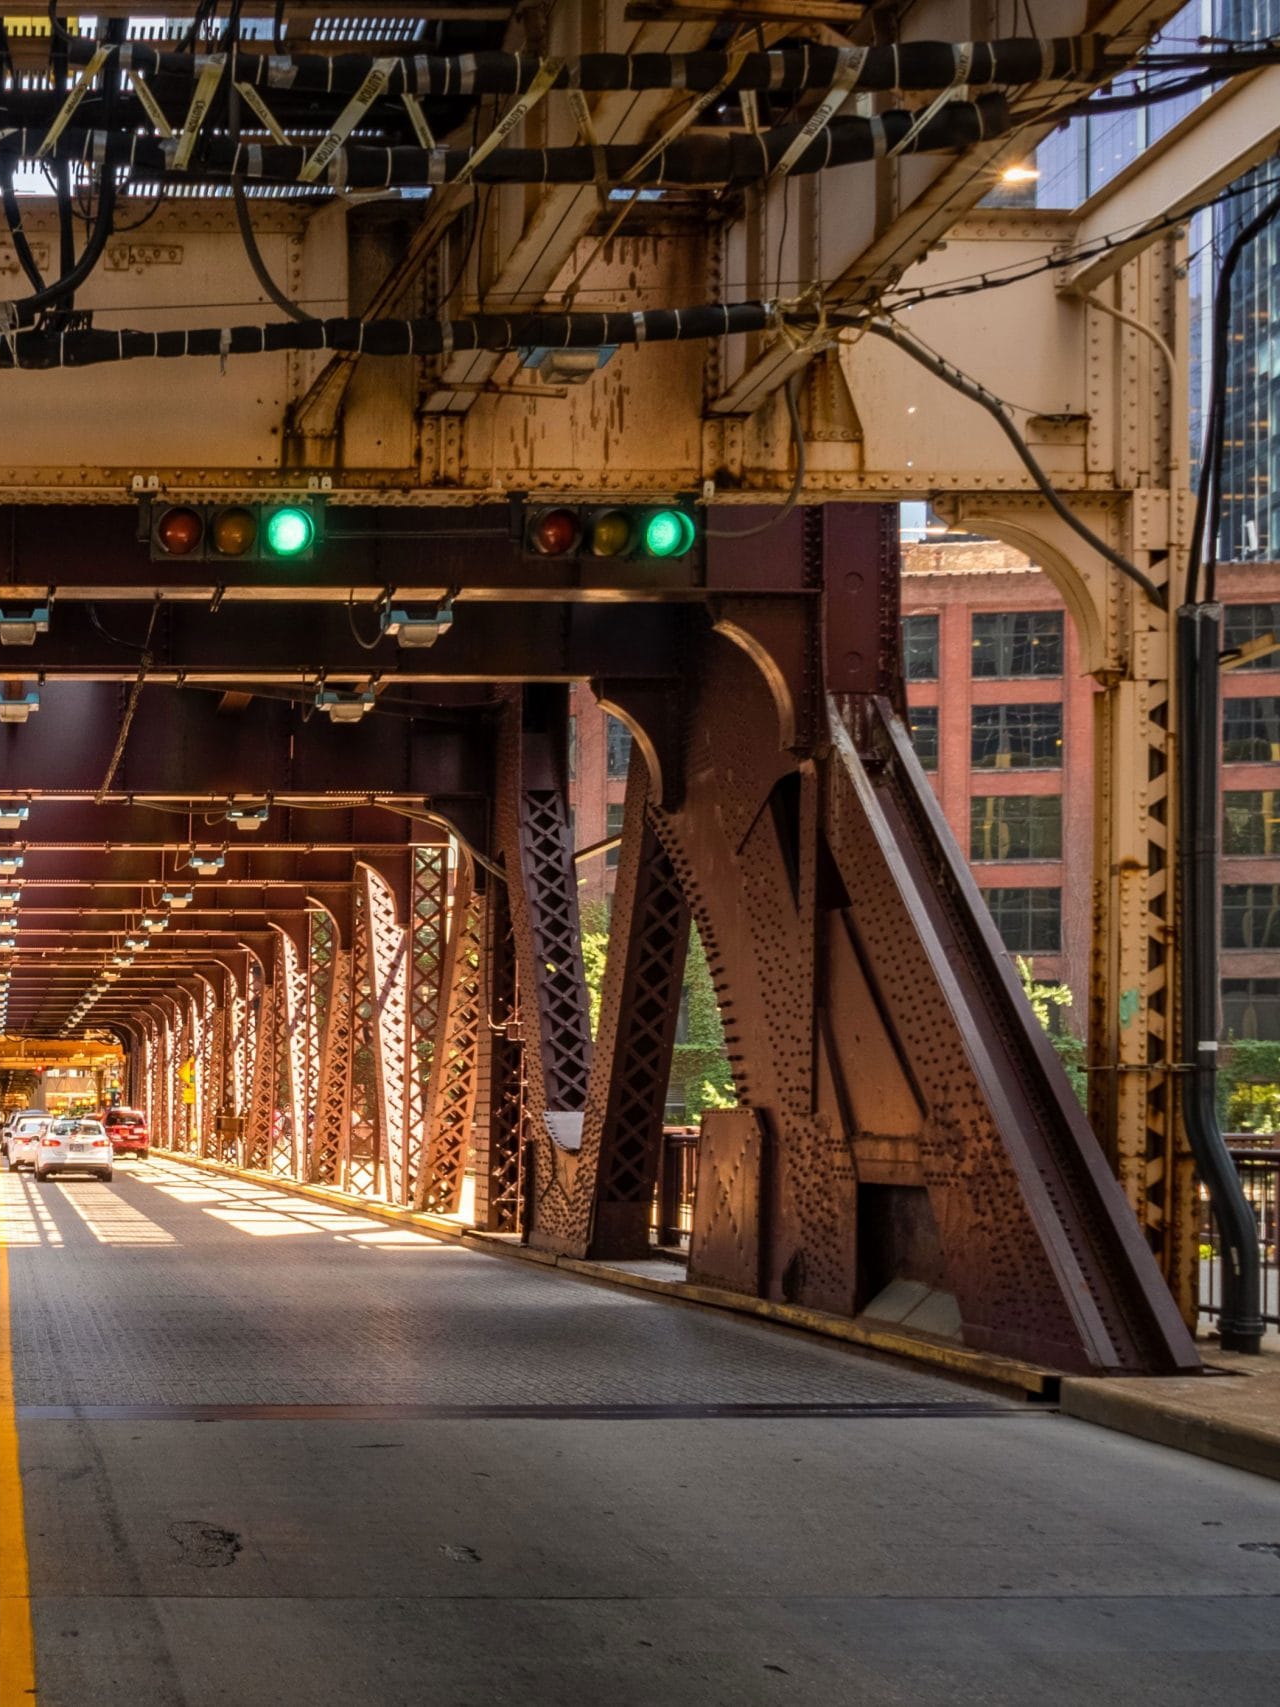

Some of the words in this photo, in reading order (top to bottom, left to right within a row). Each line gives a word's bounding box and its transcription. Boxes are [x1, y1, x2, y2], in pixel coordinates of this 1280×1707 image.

[357, 69, 386, 105] CAUTION
[498, 103, 528, 136] CAUTION
[803, 103, 833, 137] CAUTION
[313, 134, 342, 167] CAUTION
